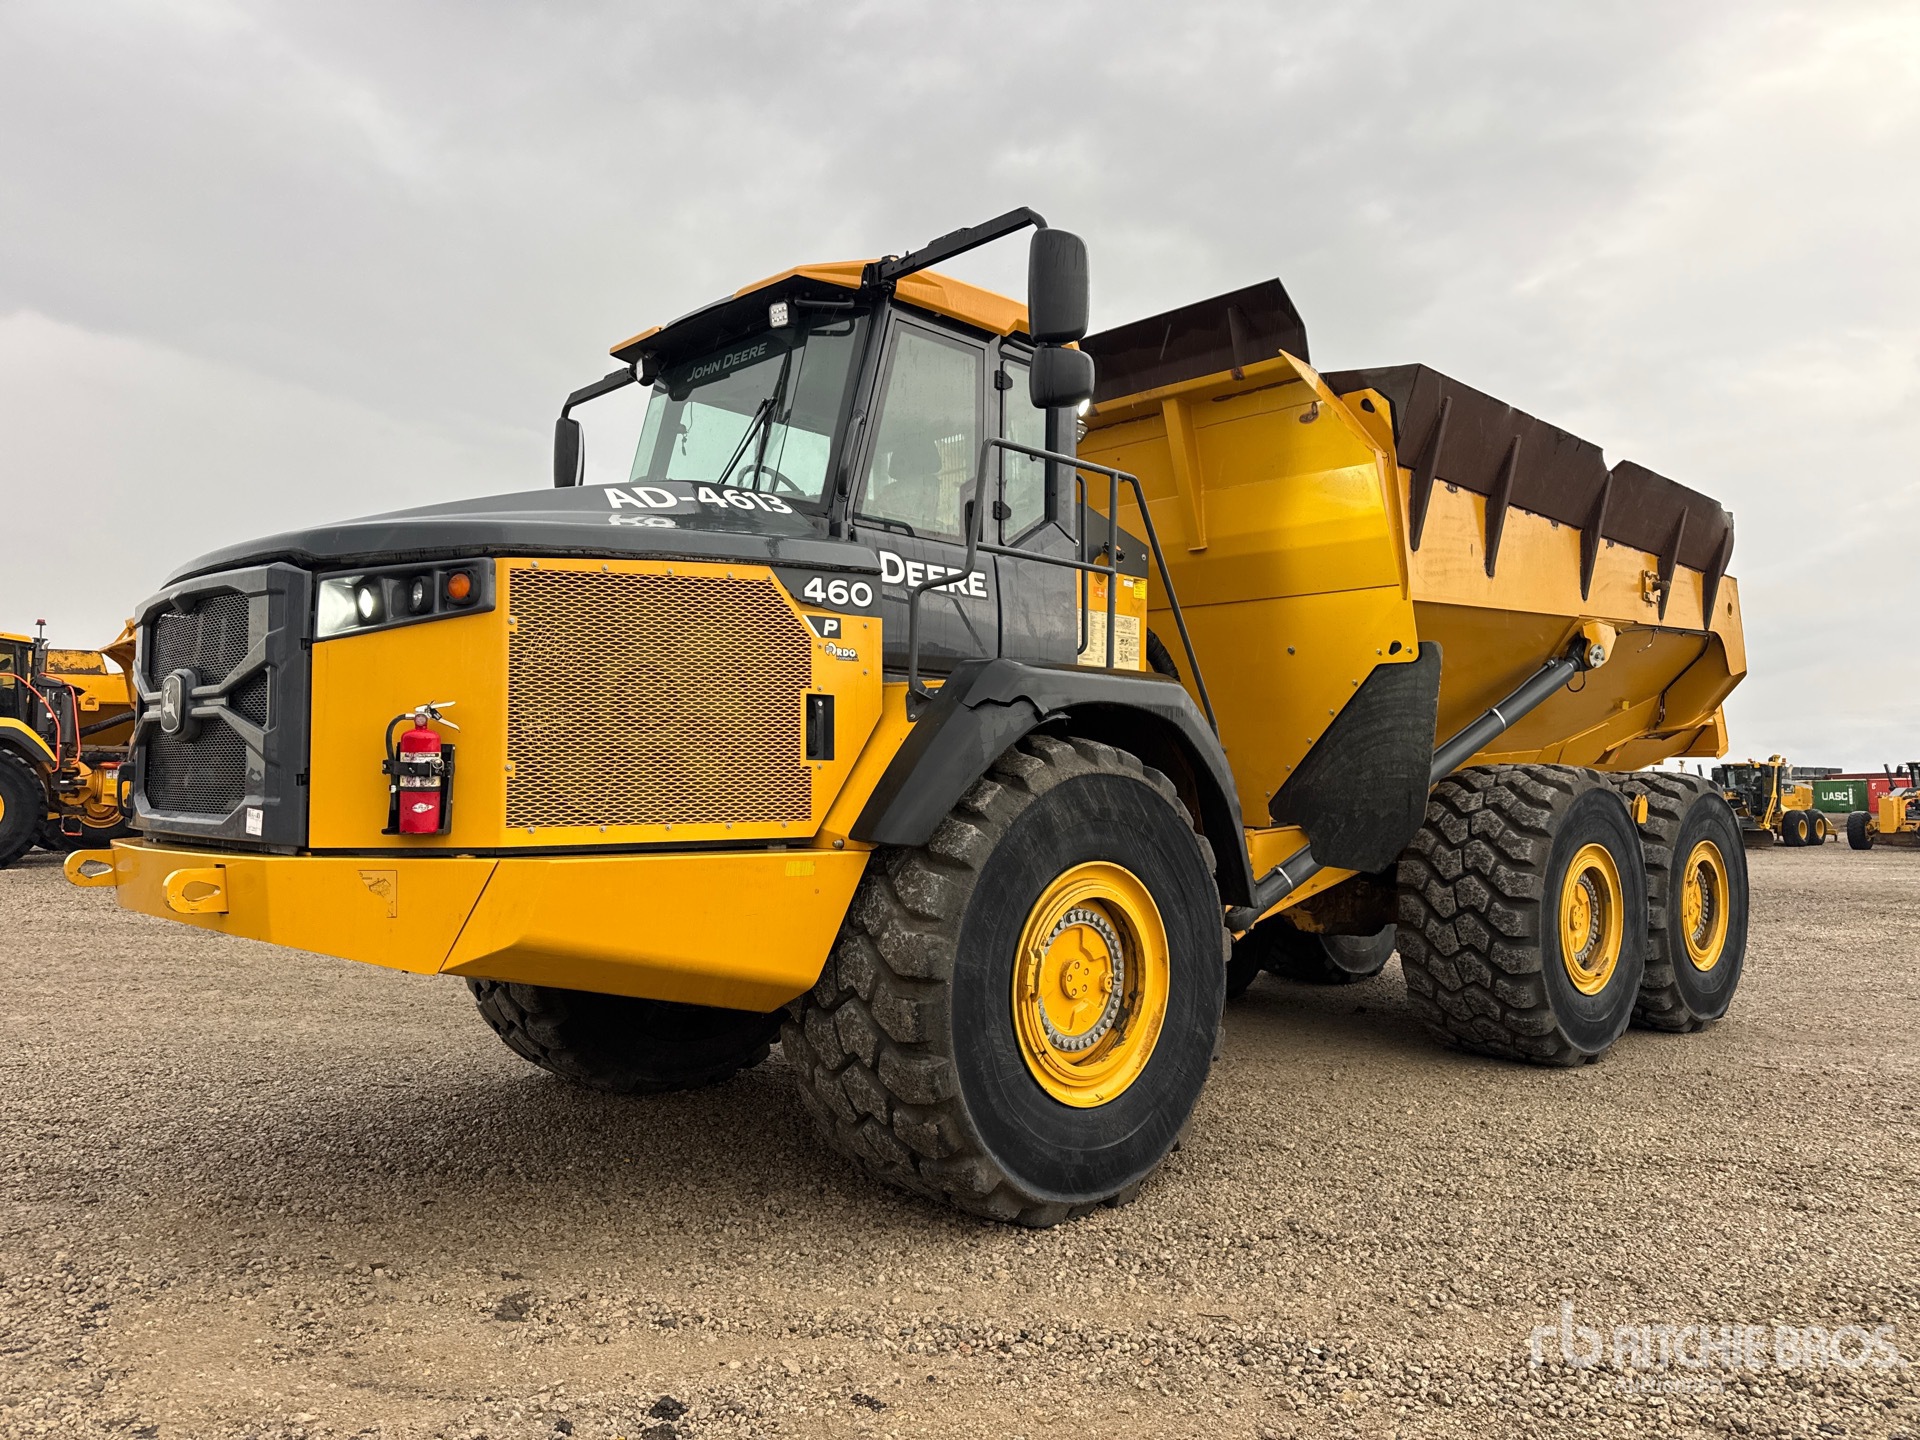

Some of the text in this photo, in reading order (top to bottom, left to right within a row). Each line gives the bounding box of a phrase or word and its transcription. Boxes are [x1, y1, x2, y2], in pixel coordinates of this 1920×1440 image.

[687, 342, 767, 382] JOHN DEERE
[604, 487, 793, 514] AD-4613
[880, 550, 987, 598] DEERE
[804, 578, 873, 607] 460
[824, 619, 838, 636] P
[1821, 791, 1848, 801] UASC
